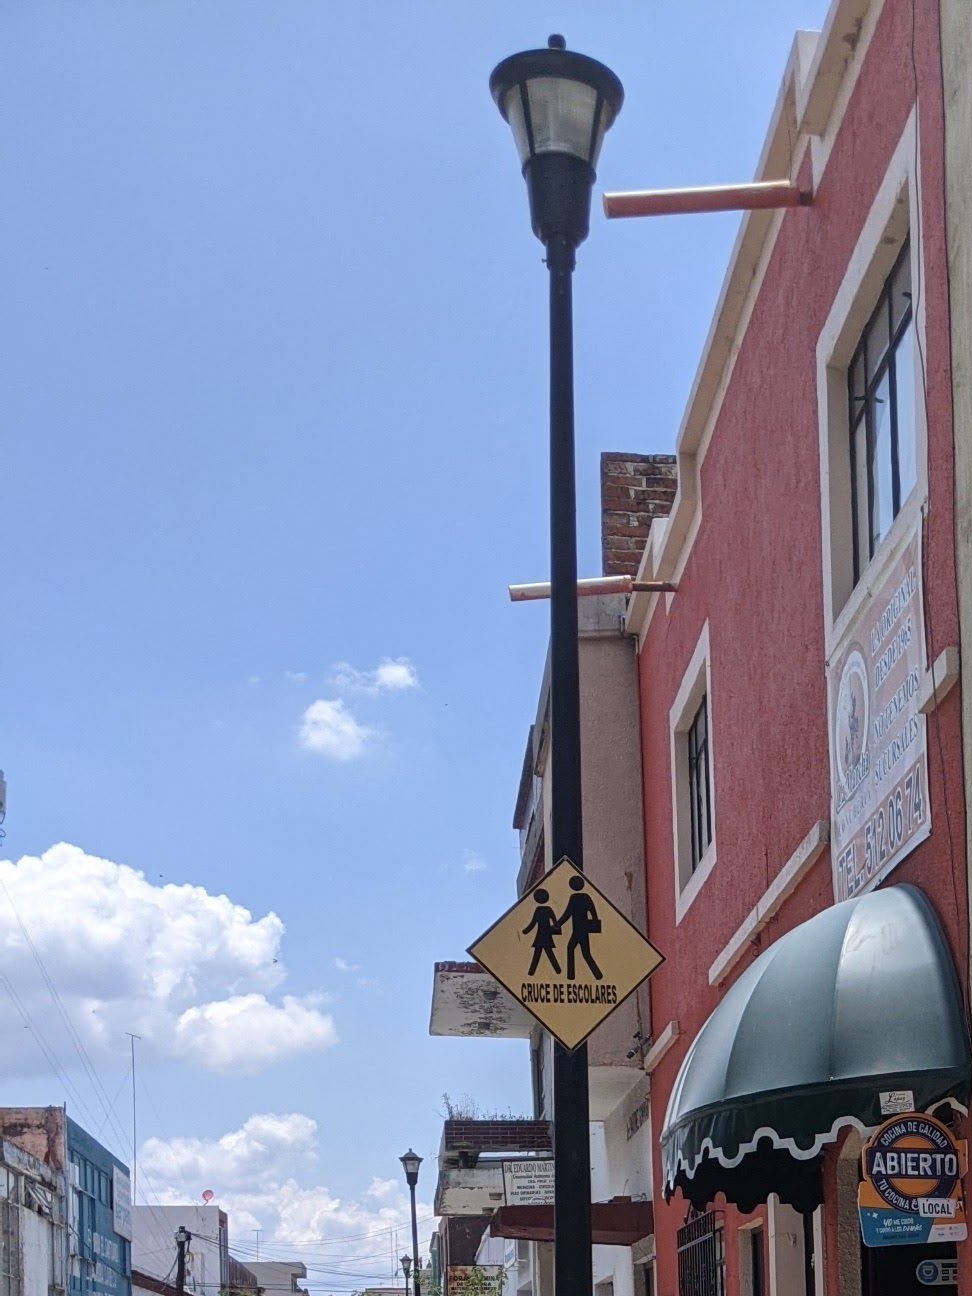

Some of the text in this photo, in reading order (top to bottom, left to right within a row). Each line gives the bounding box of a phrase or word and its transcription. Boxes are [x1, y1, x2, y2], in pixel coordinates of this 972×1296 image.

[882, 568, 916, 636] ORIGINAL
[875, 618, 912, 688] DESDE 1965
[875, 669, 919, 738] NO TENEMOS
[875, 714, 918, 785] SUCURSALES
[838, 767, 922, 899] TEL. 512 06 74
[521, 983, 617, 1004] CRUCE DE ESCOLARES
[880, 1121, 948, 1148] COCINA DE CALIDAD
[513, 1163, 536, 1173] EDUARDO
[872, 1152, 957, 1176] ABIERTO
[877, 1179, 909, 1209] TU COCINA
[922, 1203, 952, 1214] LOCAL
